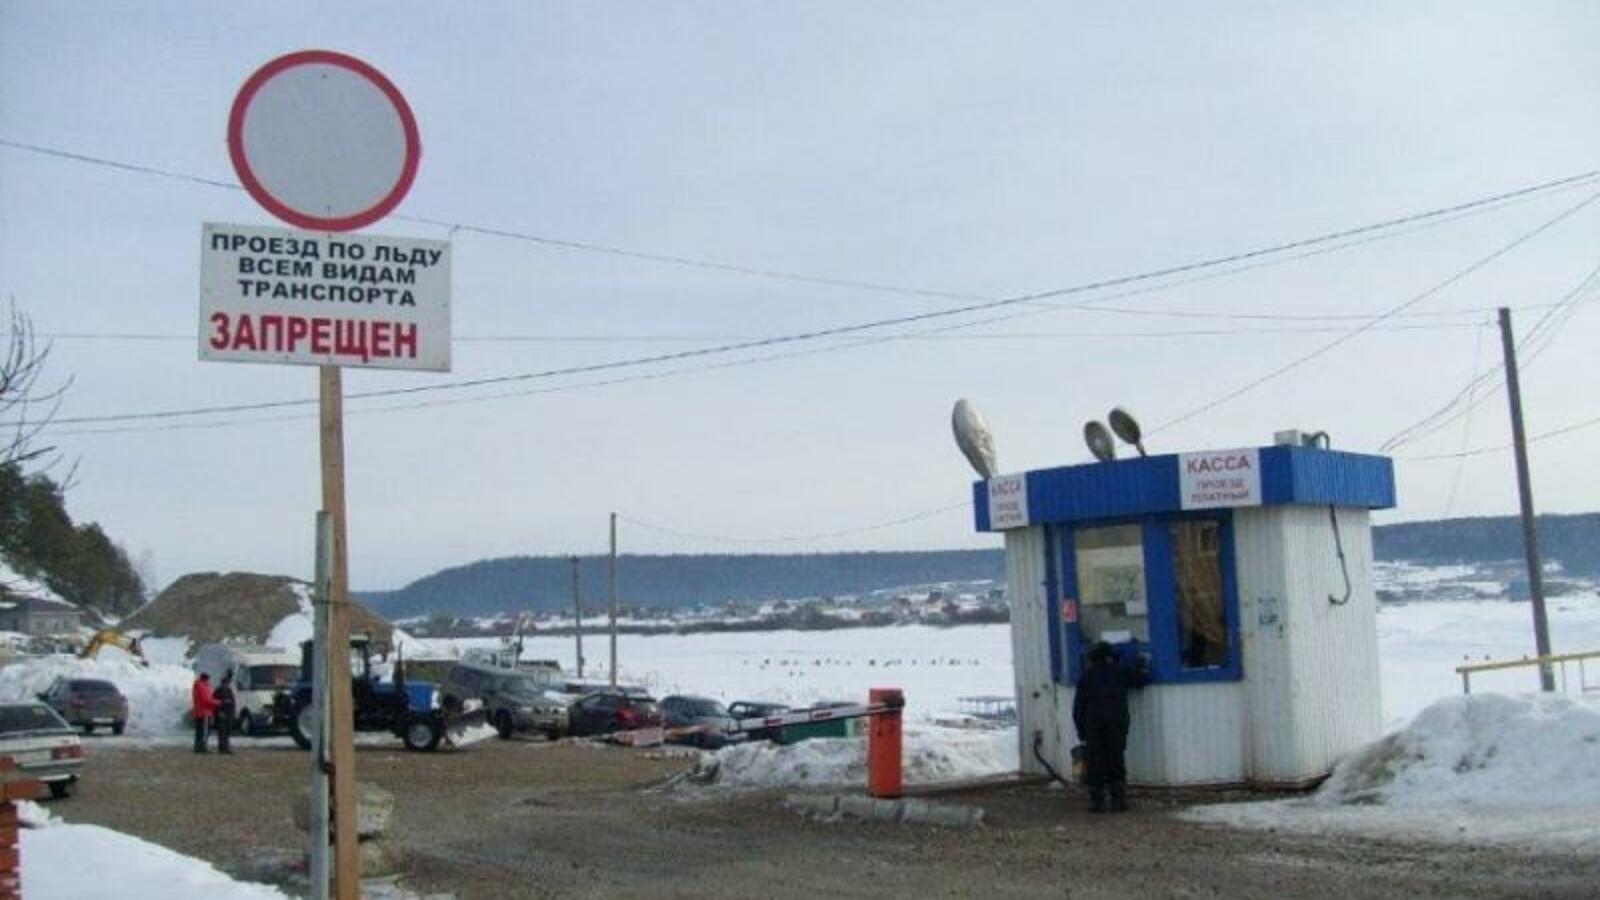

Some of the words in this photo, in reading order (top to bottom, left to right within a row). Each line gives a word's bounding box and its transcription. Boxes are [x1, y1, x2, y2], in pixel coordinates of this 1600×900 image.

[211, 234, 320, 259] ПРОЕЗД
[329, 241, 365, 259] ПО
[374, 246, 442, 267] ЛЬДУ
[239, 257, 312, 277] ВСЕМ
[322, 263, 415, 285] ВИДАМ
[238, 280, 416, 306] ТРАНСПОРТА
[210, 312, 417, 363] ЗАПРЕЩЕН
[1187, 455, 1250, 473] КАССА
